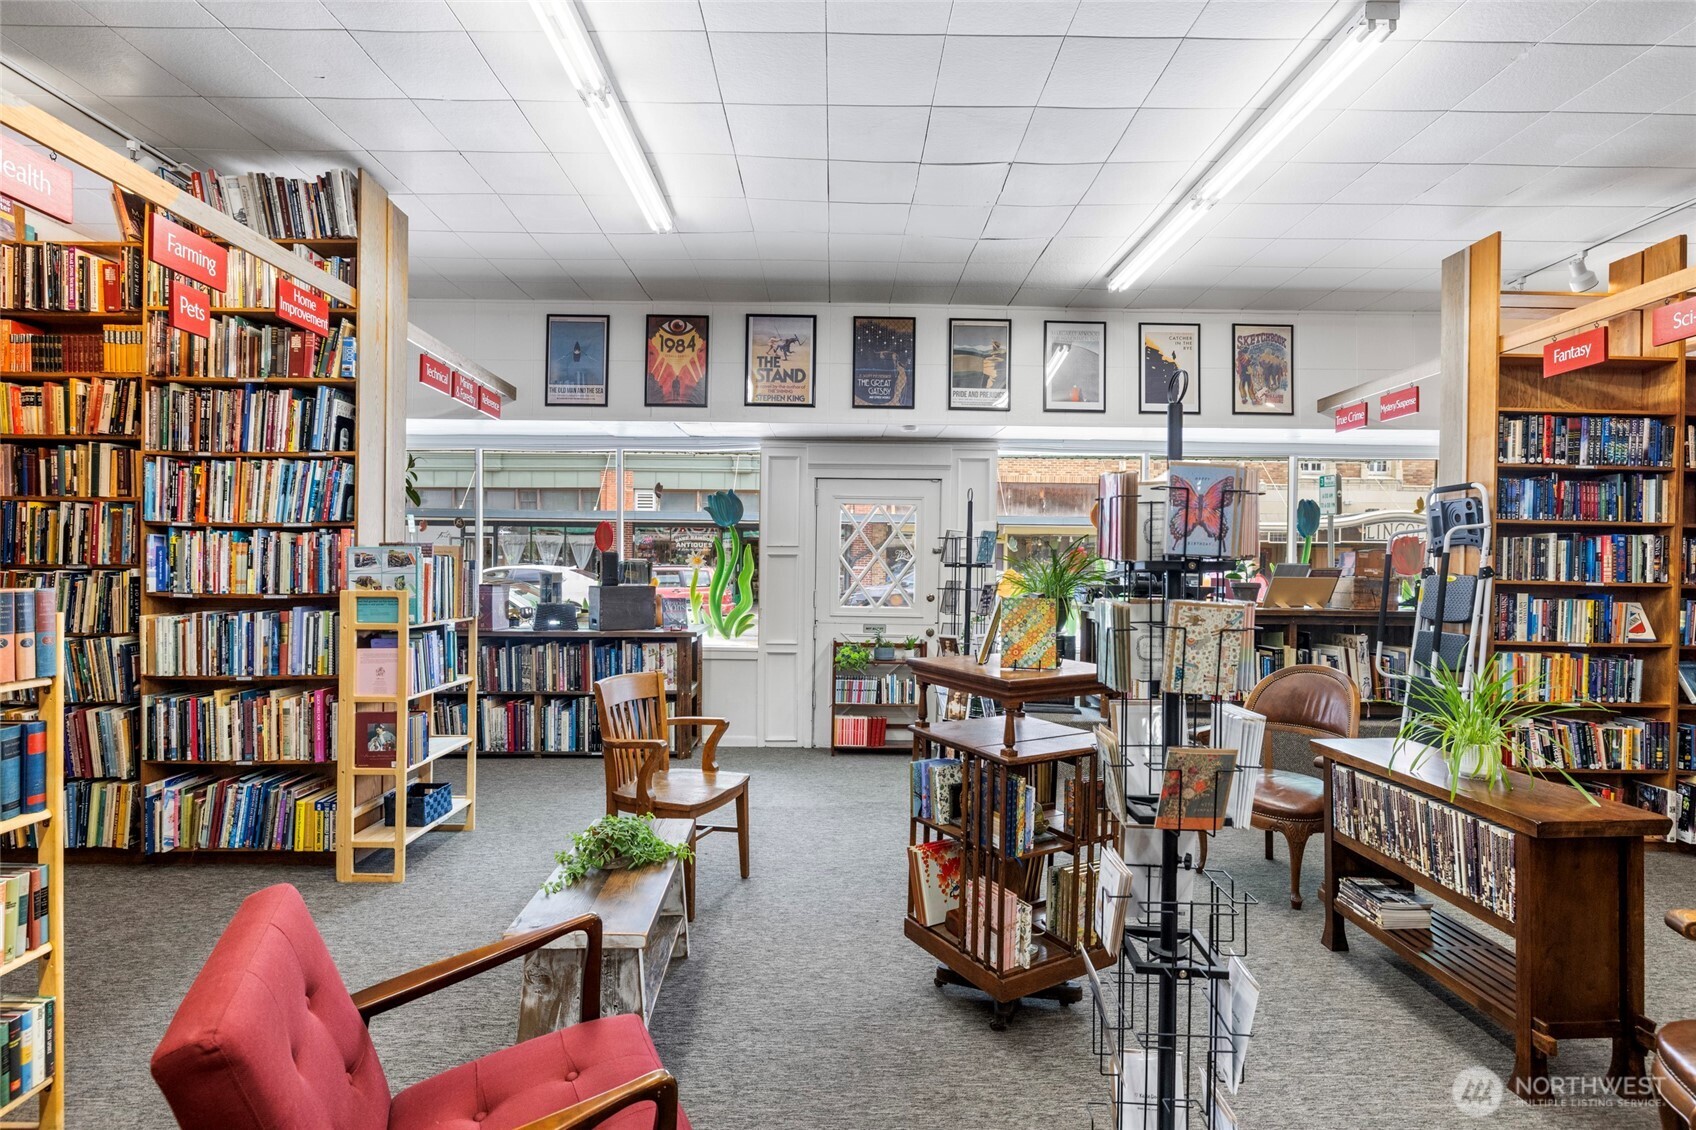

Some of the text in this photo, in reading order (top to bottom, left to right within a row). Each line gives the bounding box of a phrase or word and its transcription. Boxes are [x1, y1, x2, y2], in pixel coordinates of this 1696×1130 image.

[0, 149, 52, 196] ealth
[167, 232, 217, 277] Farming
[180, 295, 205, 321] Pets
[293, 288, 317, 311] Home
[280, 296, 329, 331] Improvement
[659, 334, 696, 353] 1984
[1237, 332, 1287, 349] SKETCHBOOK
[757, 356, 781, 368] THE
[1553, 343, 1592, 364] Fantasy
[426, 363, 448, 385] Technical
[756, 368, 806, 383] STAND
[857, 379, 891, 387] THE GREAT
[868, 387, 892, 396] GATSBY
[755, 394, 785, 402] STEPHEN
[952, 390, 967, 398] PRIDE
[1335, 410, 1365, 426] True Crime
[1367, 523, 1427, 539] LINCOL
